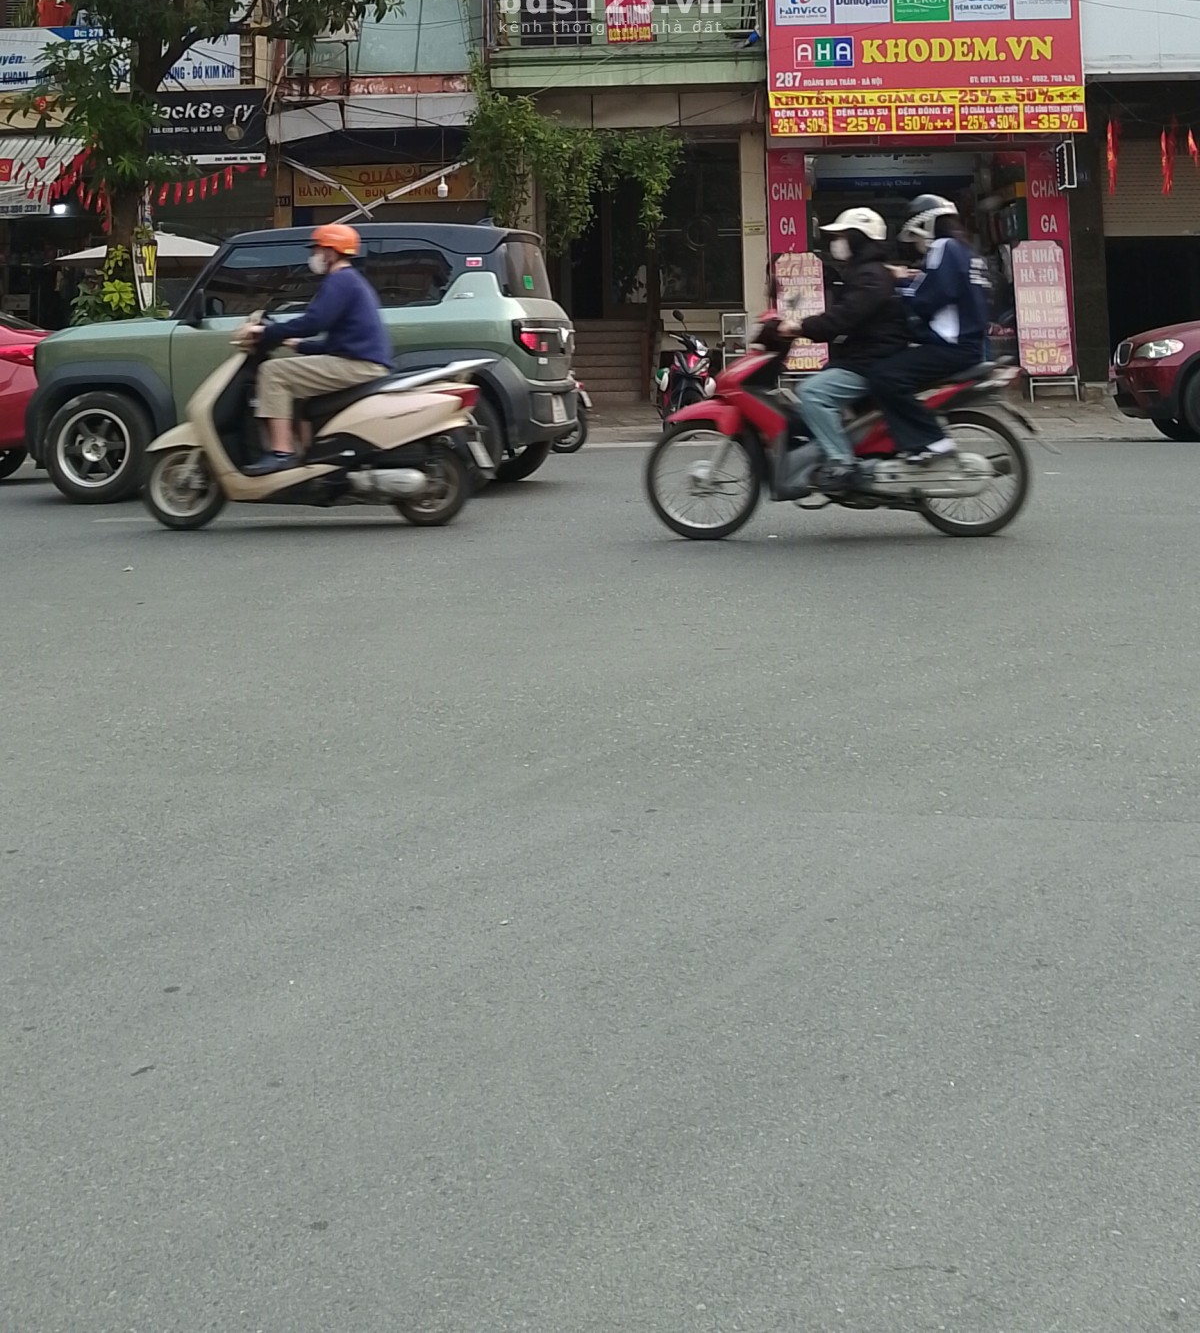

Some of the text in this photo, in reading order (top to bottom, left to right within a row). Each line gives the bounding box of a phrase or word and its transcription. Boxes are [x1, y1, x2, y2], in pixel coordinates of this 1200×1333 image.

[797, 35, 1053, 64] AHA KHODEM.VN
[204, 65, 220, 78] KIM
[776, 71, 802, 87] 287
[838, 94, 866, 108] MẠI
[949, 89, 996, 103] -25%
[774, 108, 795, 118] ĐỆM
[812, 109, 824, 117] XO
[836, 107, 888, 117] ĐỆM CAO SU
[840, 116, 886, 132] -25%
[1031, 113, 1079, 129] -35%
[299, 185, 312, 197] HÀ
[771, 178, 802, 201] CHĂN
[780, 217, 796, 235] GA
[1041, 214, 1057, 233] GA
[1025, 348, 1067, 365] 50%
